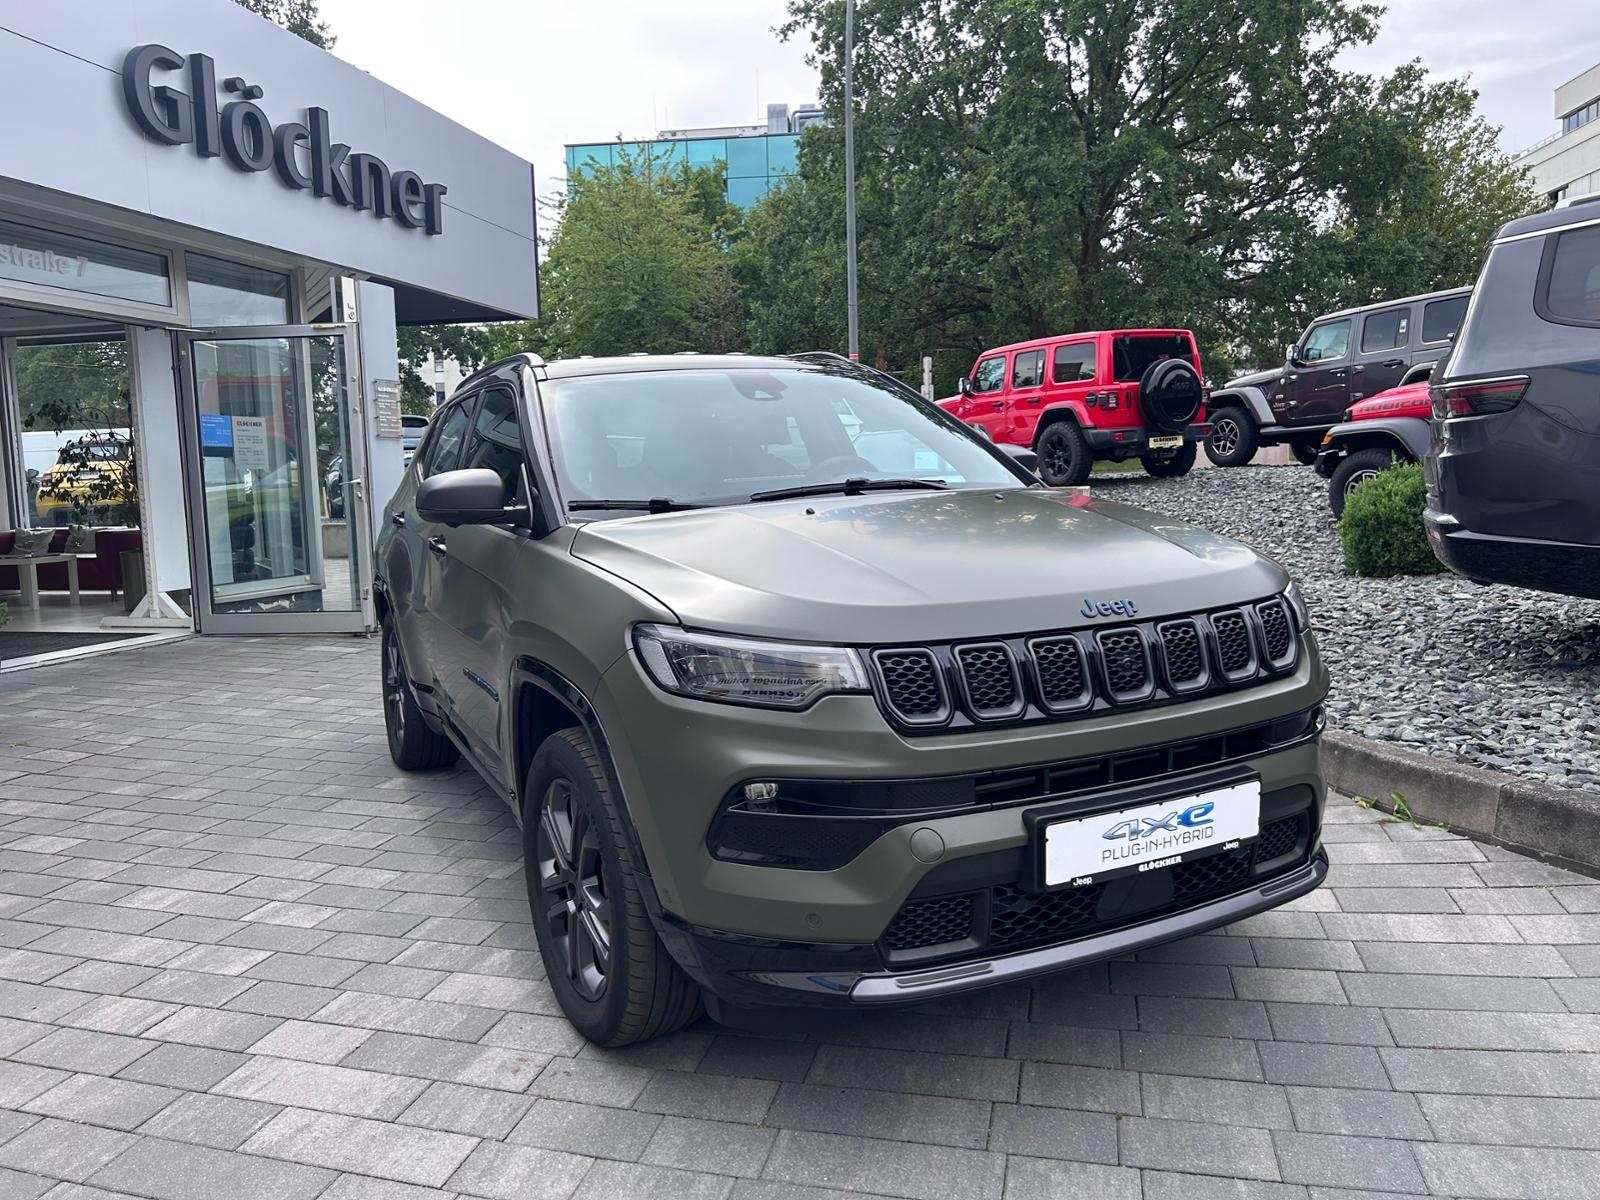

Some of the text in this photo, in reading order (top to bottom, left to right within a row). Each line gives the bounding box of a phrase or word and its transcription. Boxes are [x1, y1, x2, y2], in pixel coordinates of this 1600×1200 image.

[123, 44, 447, 235] Glöckner
[76, 256, 88, 278] 7
[1080, 597, 1138, 619] Jeep
[1102, 825, 1214, 862] PLUG-IN-HYBRID
[1222, 841, 1240, 850] Jeep
[1073, 876, 1093, 886] Jeep
